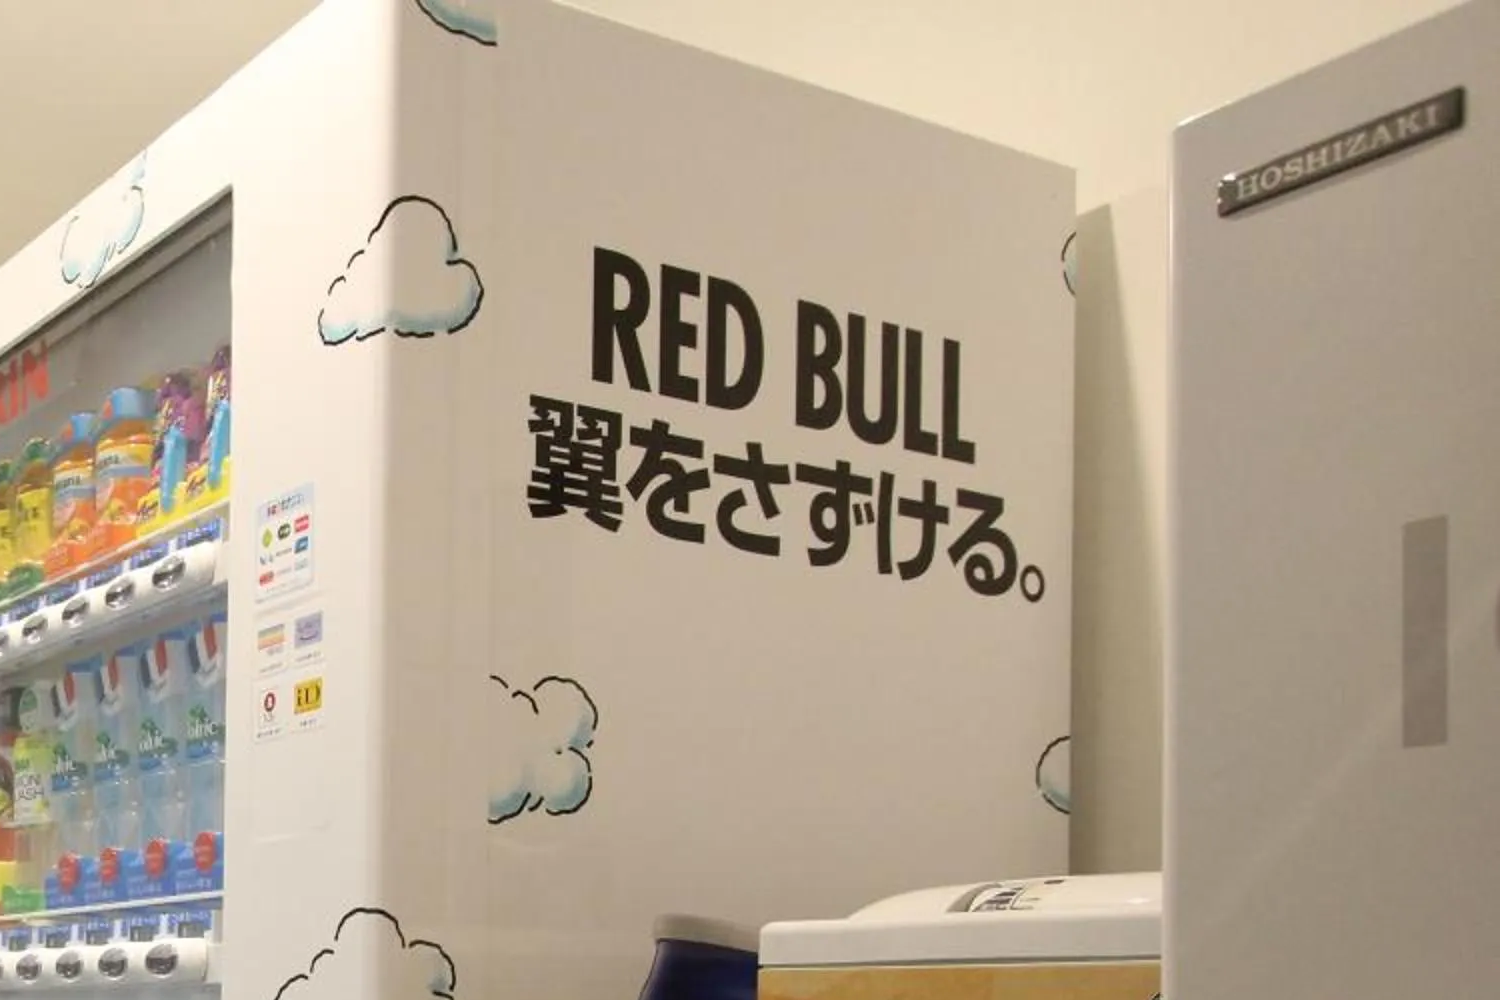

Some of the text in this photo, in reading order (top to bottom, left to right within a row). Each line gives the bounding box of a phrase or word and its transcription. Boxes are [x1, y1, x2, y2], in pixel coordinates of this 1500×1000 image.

[1234, 104, 1440, 202] HOSHIZAKI
[591, 246, 976, 464] RED BULL
[526, 394, 1045, 603] 翼をさずける。
